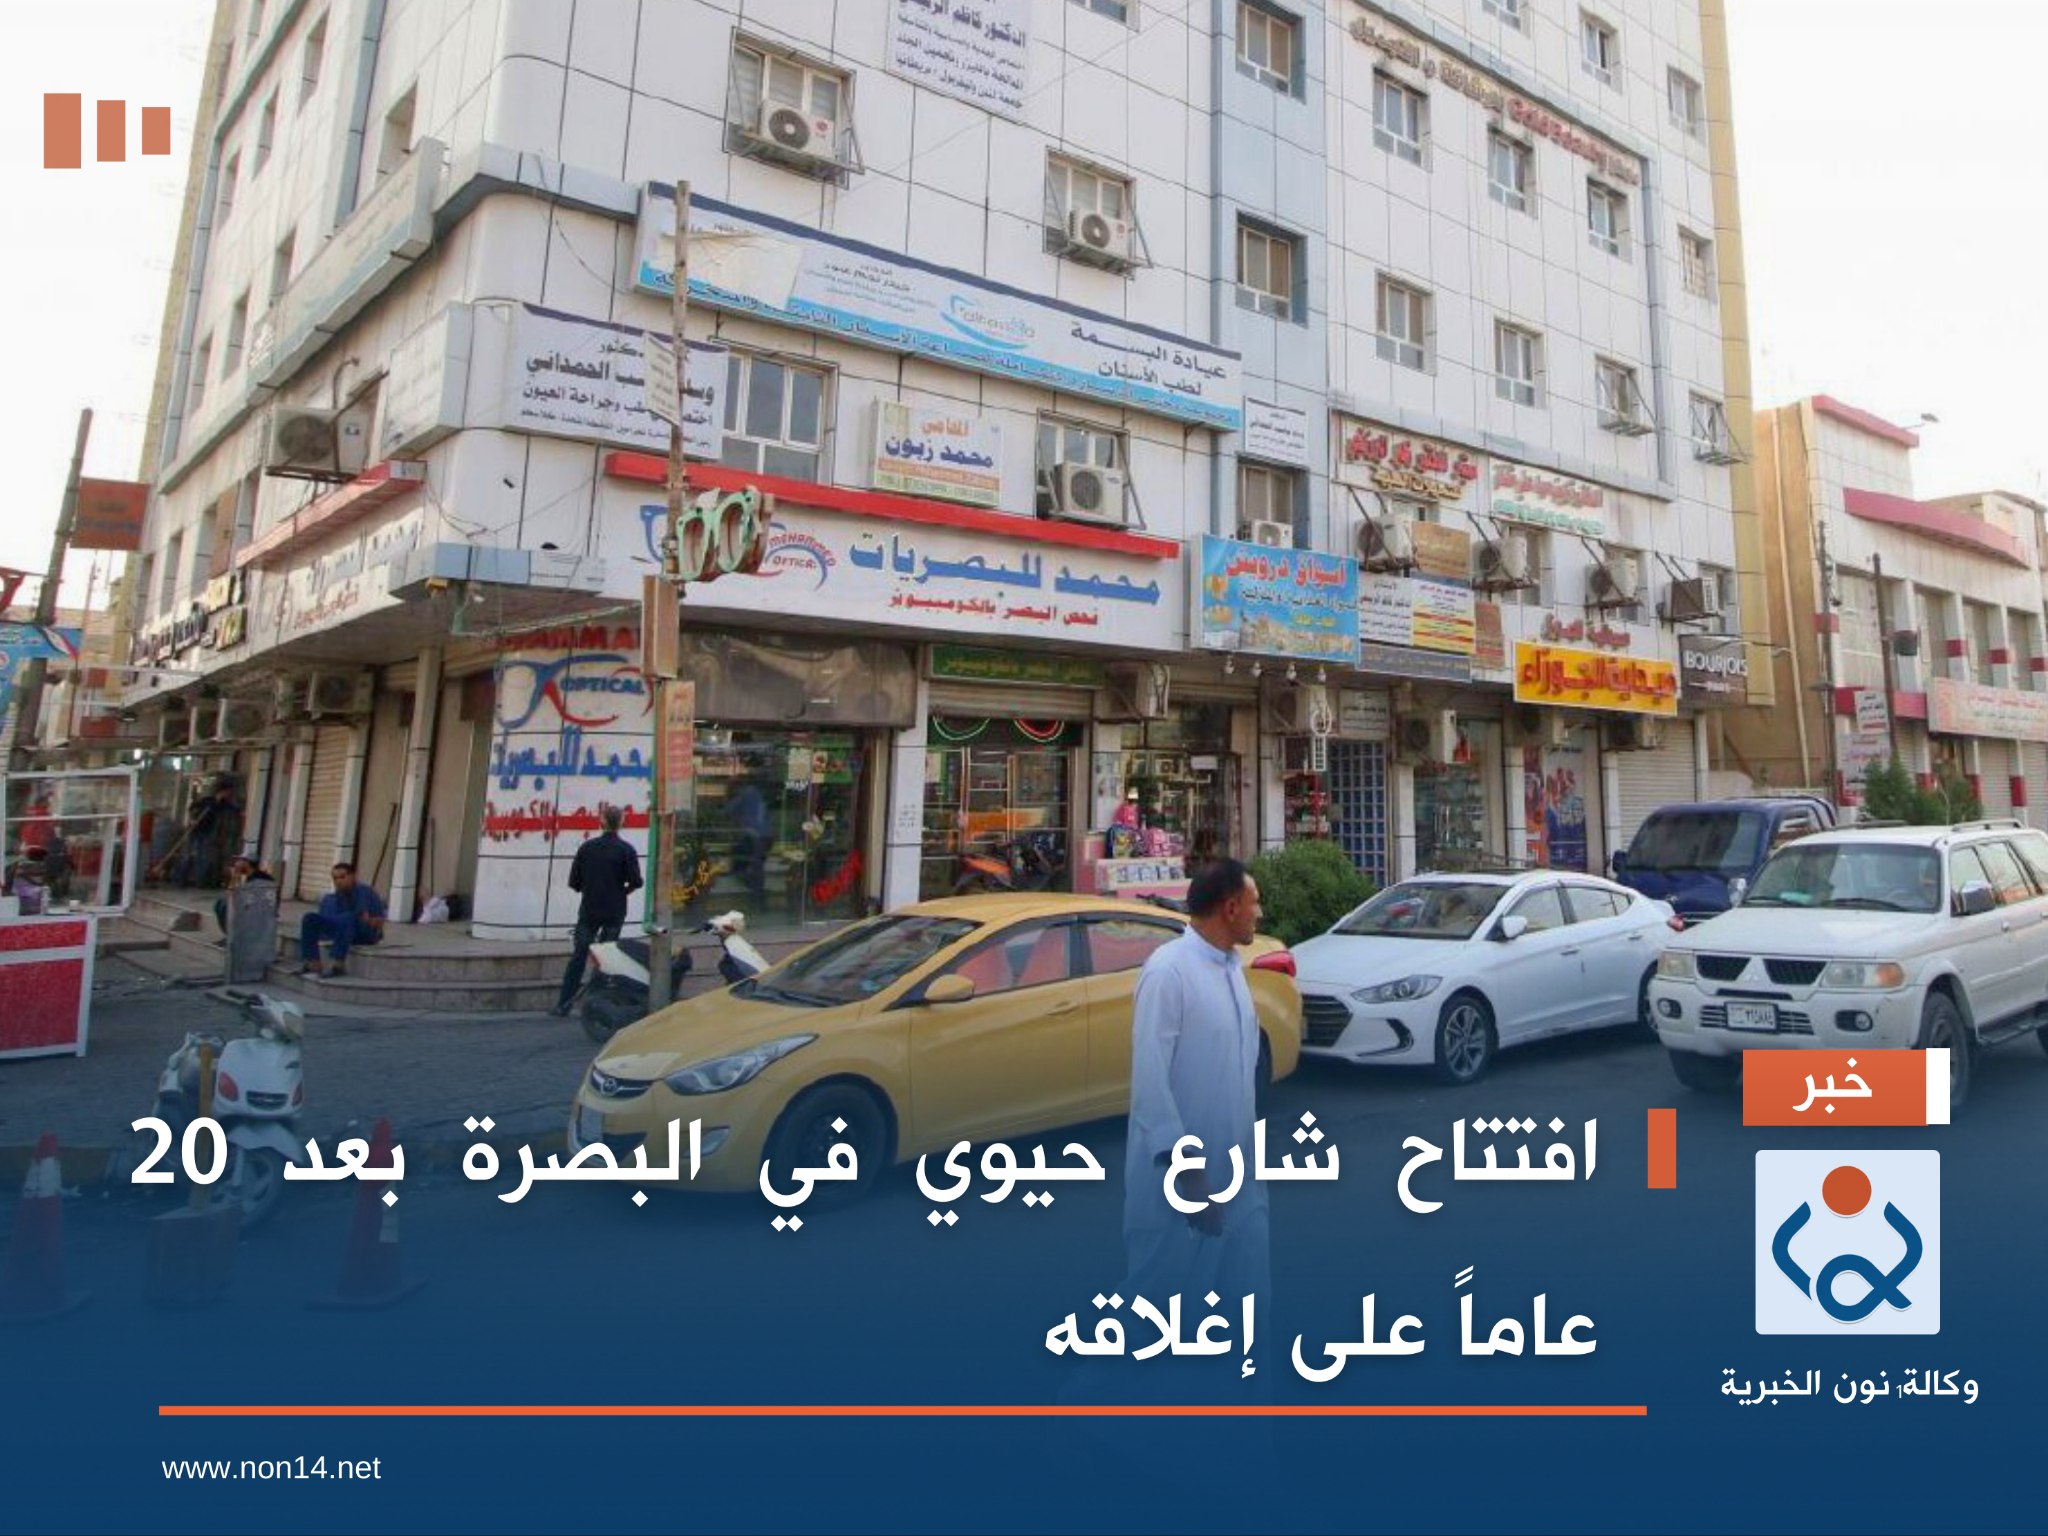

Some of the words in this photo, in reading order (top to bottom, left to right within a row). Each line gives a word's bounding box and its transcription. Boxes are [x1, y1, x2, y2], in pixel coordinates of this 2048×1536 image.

[1070, 318, 1167, 360] البسمة
[526, 351, 610, 382] الحمداني
[1173, 352, 1228, 380] عيادة
[568, 388, 620, 411] وجراحة
[940, 444, 994, 468] محمد
[850, 531, 1043, 597] للبصريات
[1053, 564, 1161, 607] محمد
[1002, 603, 1058, 626] البصر
[1062, 606, 1100, 627] فحص
[1684, 649, 1748, 678] BOURJOIS
[560, 676, 644, 696] OPTICAL
